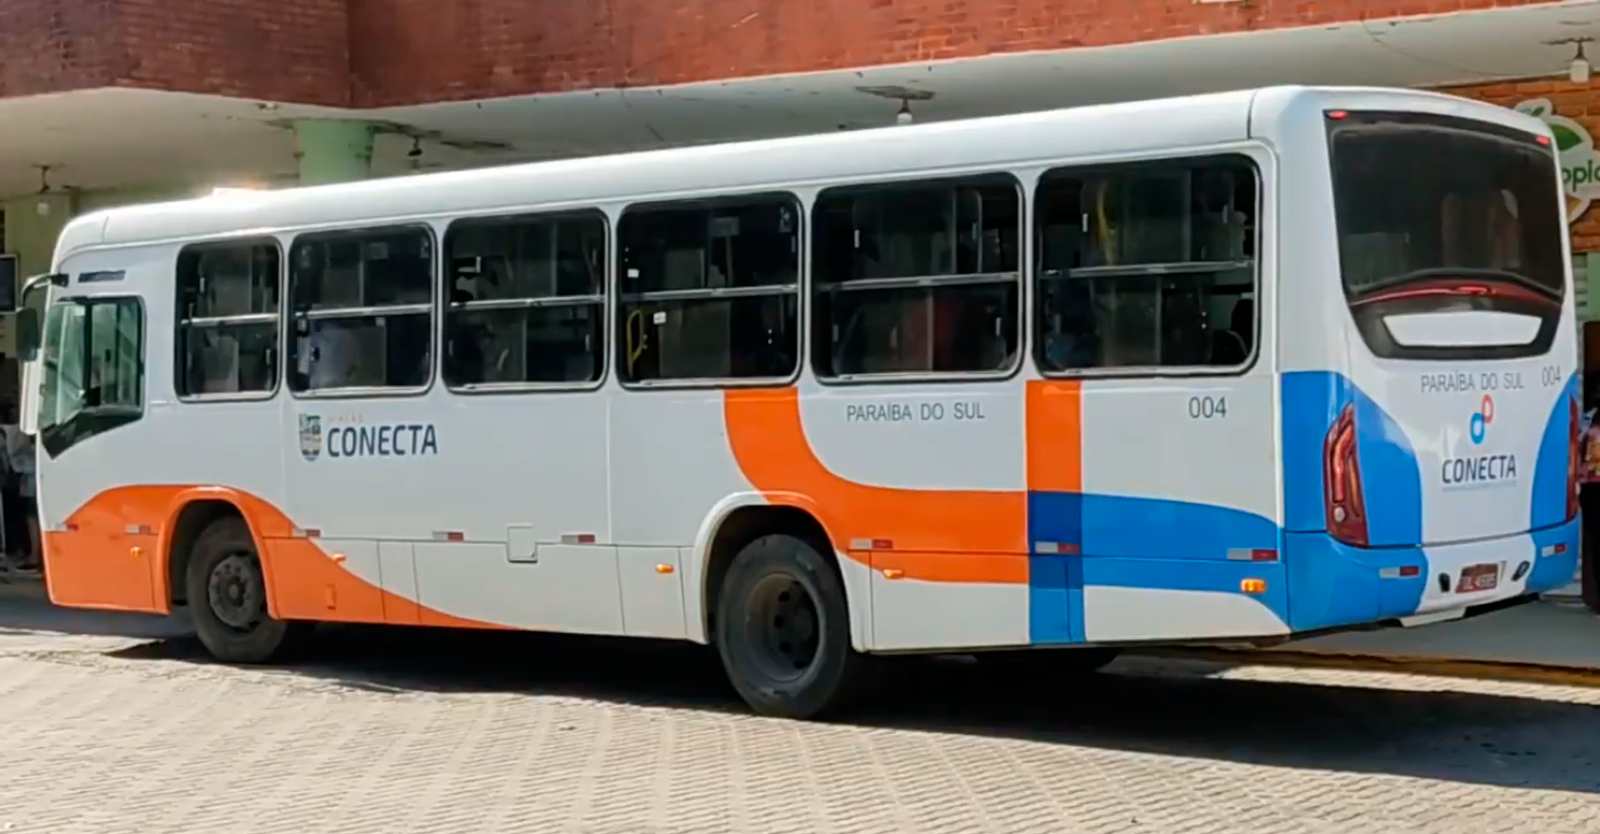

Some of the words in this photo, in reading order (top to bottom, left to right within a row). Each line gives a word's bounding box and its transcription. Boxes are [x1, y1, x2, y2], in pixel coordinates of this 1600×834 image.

[1480, 373, 1498, 391] DO
[1503, 372, 1525, 389] SUL
[1541, 365, 1562, 387] 004
[920, 402, 945, 421] DO
[953, 401, 986, 420] SUL
[1188, 395, 1227, 419] 004
[327, 423, 438, 457] CONECTA
[1441, 454, 1517, 484] CONECTA
